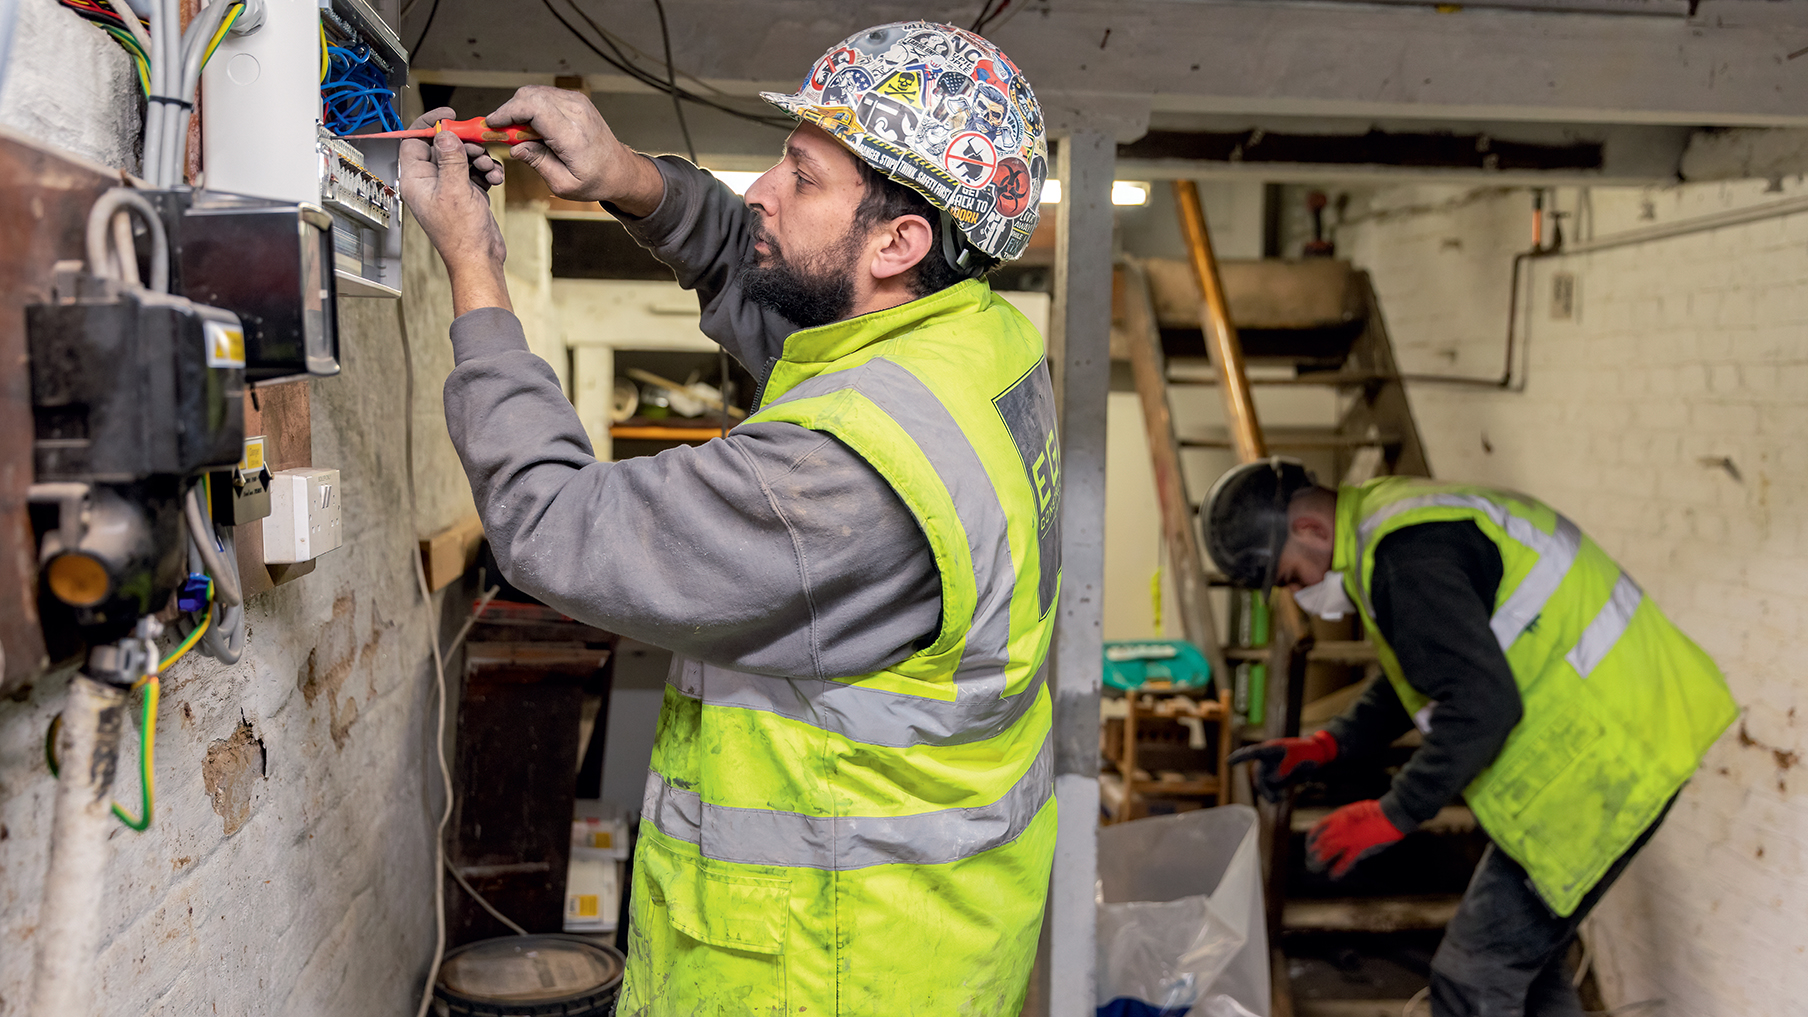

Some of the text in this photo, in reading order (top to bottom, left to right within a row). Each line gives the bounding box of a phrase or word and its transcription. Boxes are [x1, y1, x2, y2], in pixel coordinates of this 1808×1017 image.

[950, 57, 970, 74] OPLE
[898, 160, 918, 180] THINK.
[933, 183, 952, 201] FIRST
[953, 194, 988, 213] ACK TO
